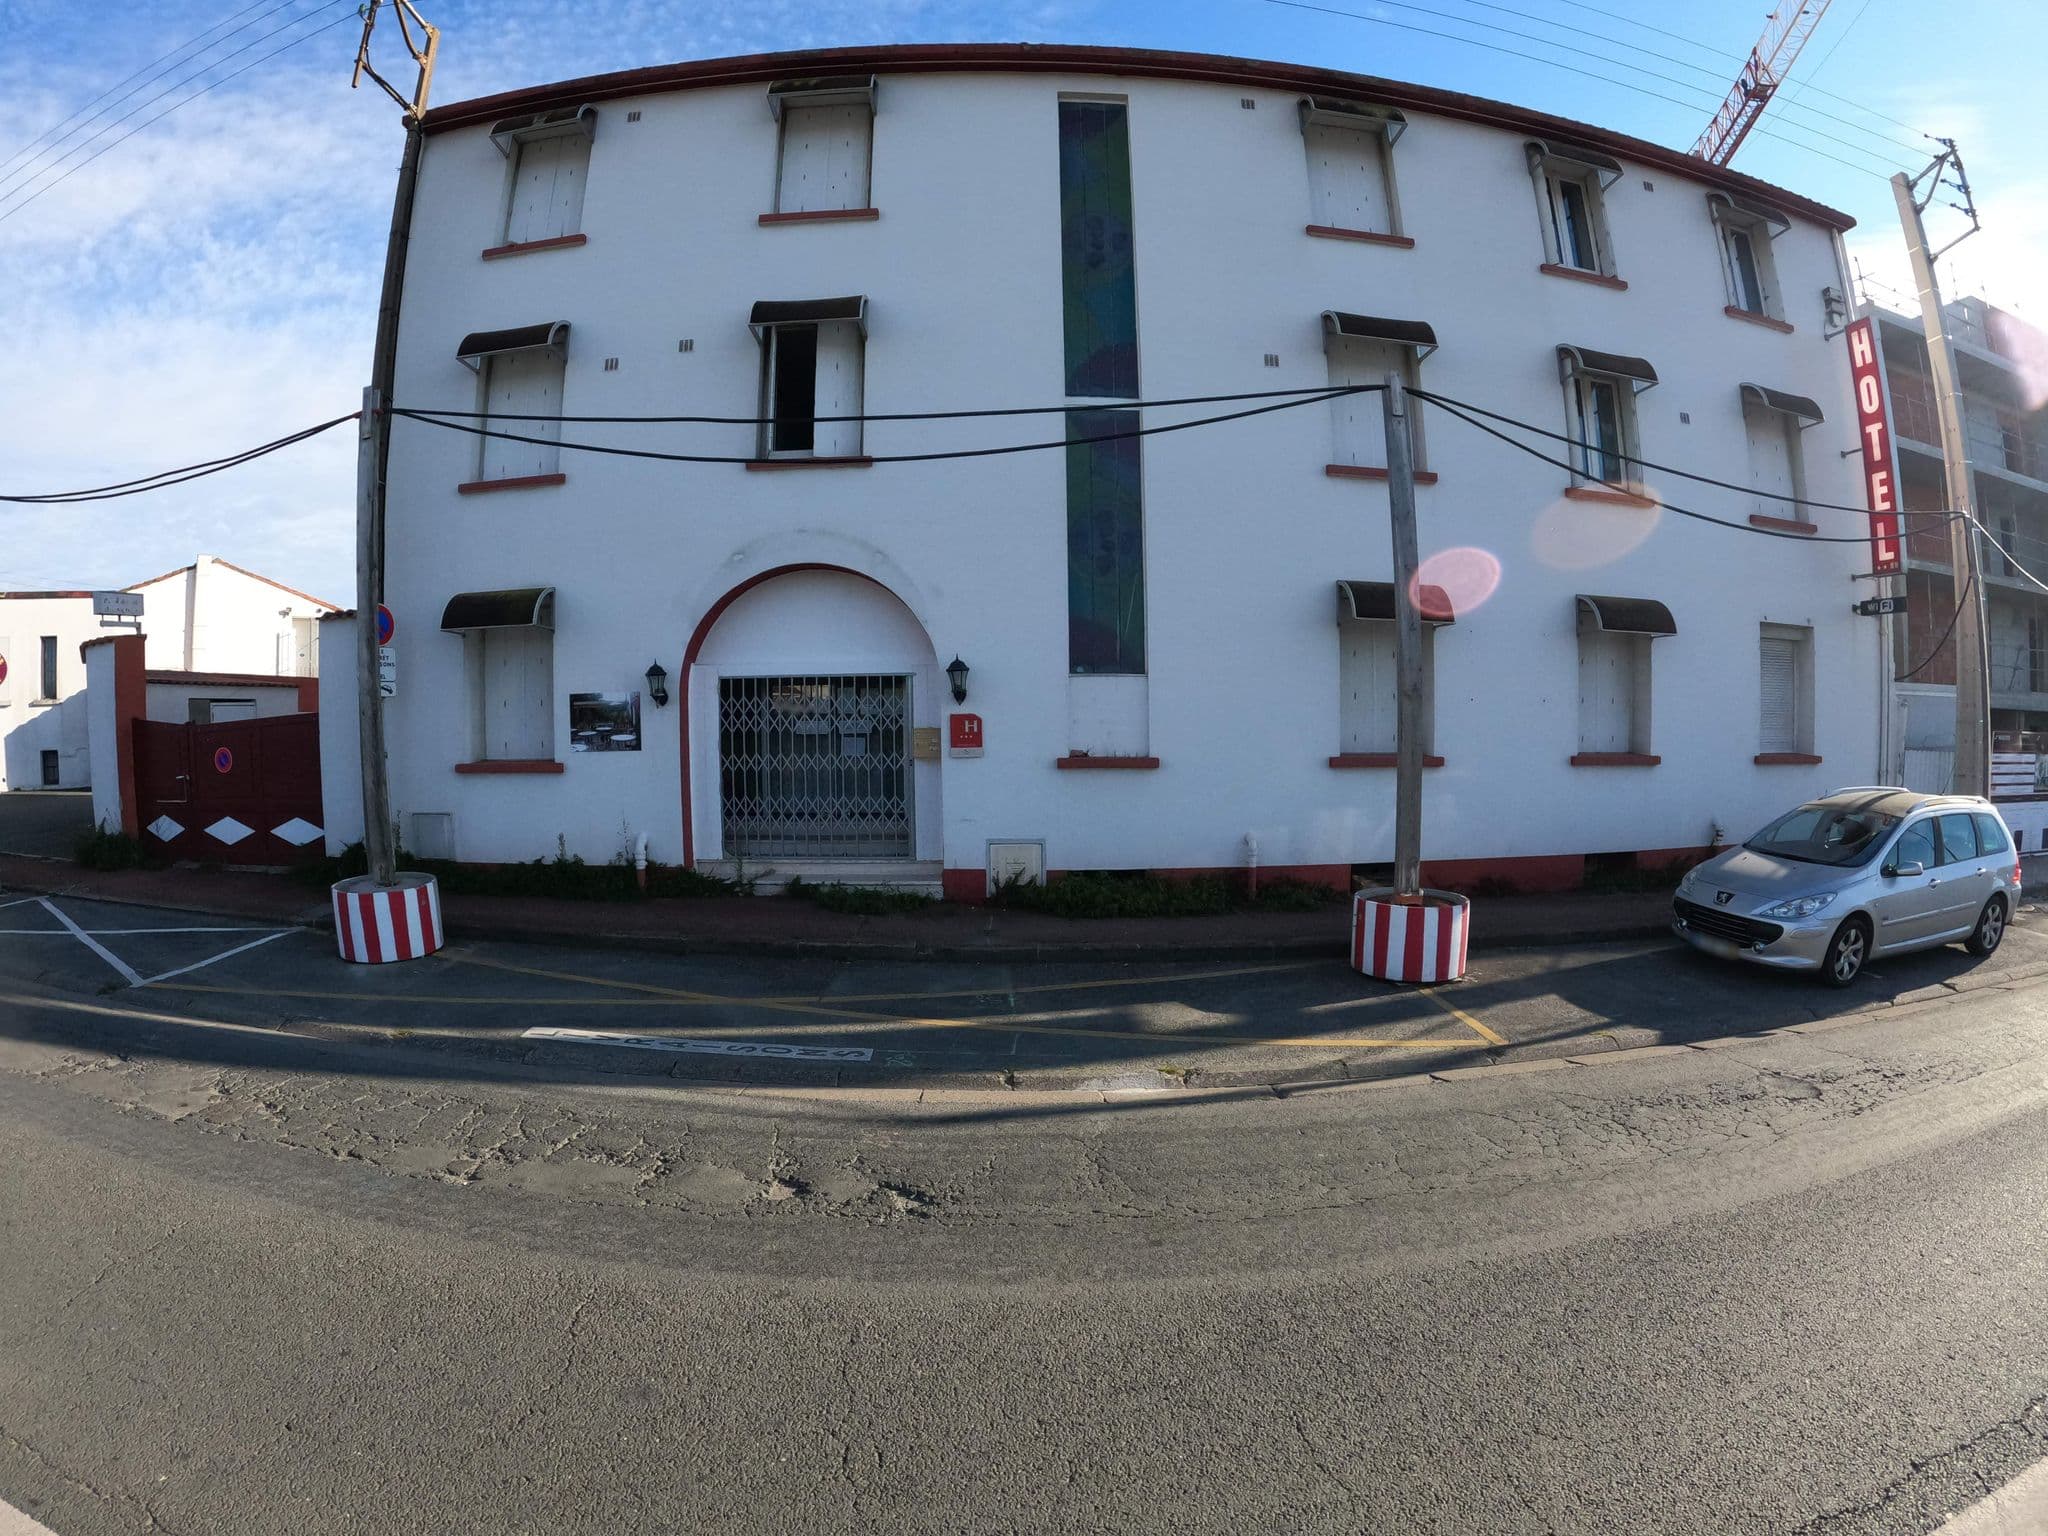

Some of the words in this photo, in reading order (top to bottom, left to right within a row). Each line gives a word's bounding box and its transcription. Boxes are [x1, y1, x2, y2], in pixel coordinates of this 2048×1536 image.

[1851, 327, 1895, 561] HOTEL
[965, 720, 978, 732] H
[527, 1029, 867, 1058] LIVRAISONS
